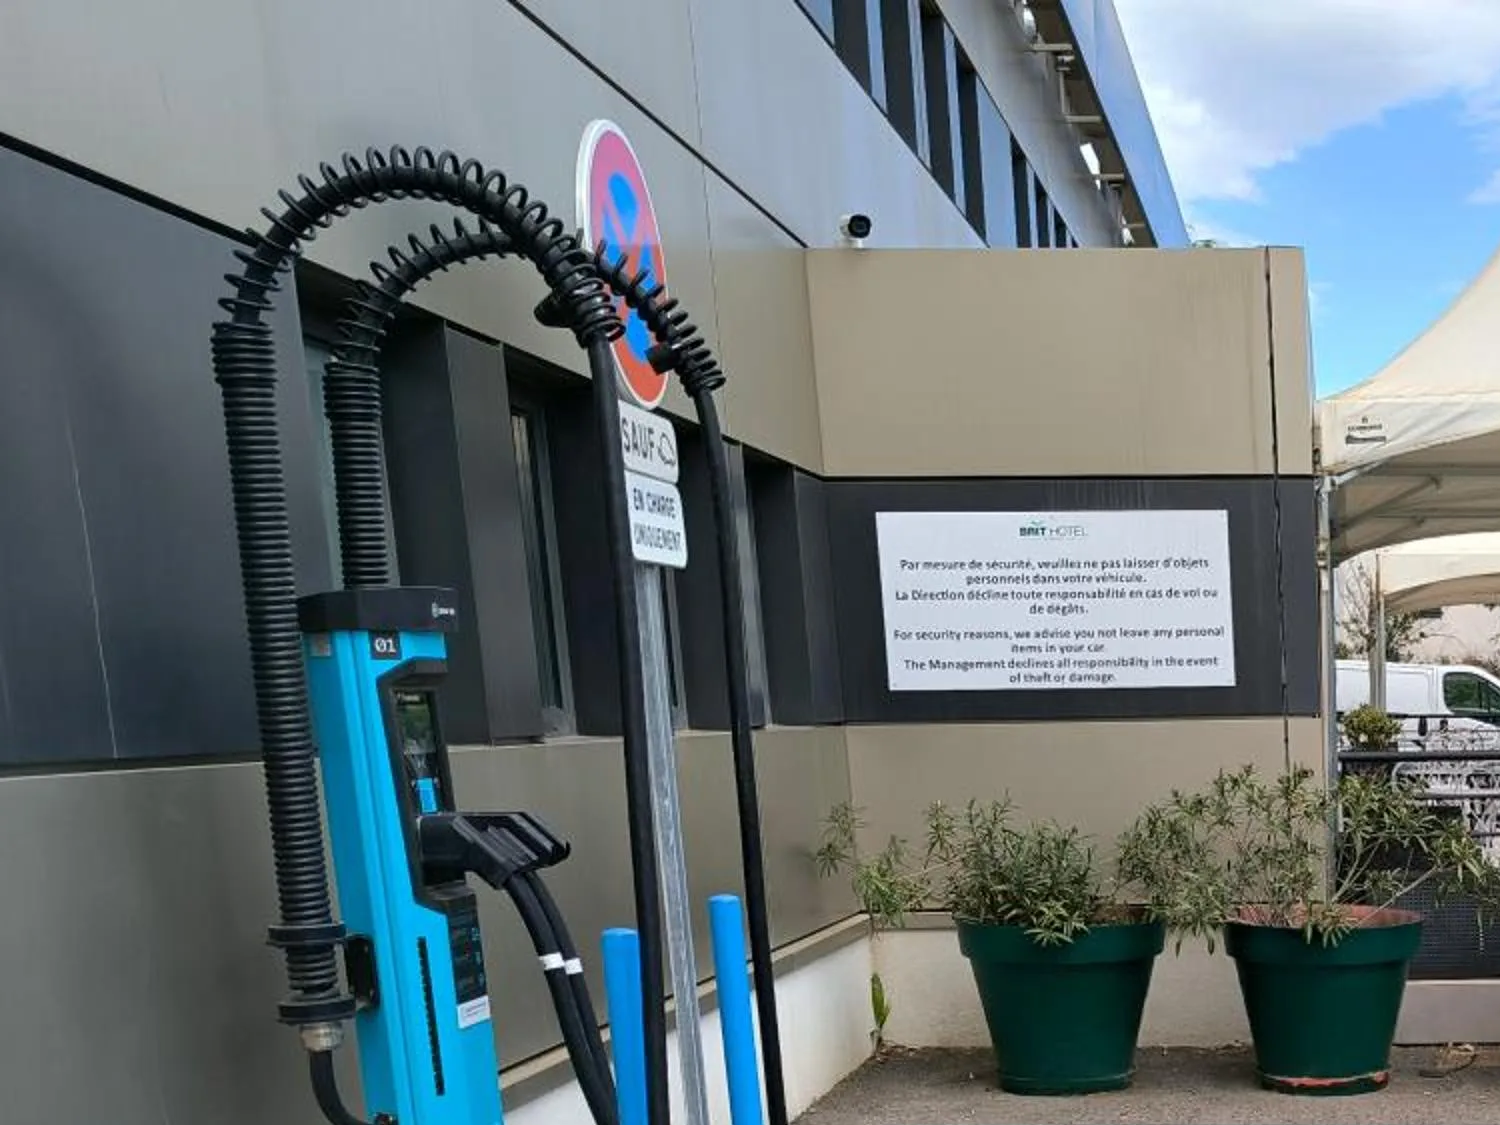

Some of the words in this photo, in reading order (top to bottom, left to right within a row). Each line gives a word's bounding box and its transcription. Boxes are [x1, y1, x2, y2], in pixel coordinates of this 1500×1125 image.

[621, 418, 655, 461] SAUF
[1049, 526, 1088, 536] HOTEL
[900, 559, 919, 570] Par
[922, 560, 966, 570] mesure
[968, 559, 983, 569] de
[985, 559, 1035, 570] sécurité,
[1037, 558, 1081, 569] veuillez
[1083, 559, 1098, 569] ne
[1101, 559, 1121, 571] pas
[1123, 557, 1160, 568] laisser
[966, 574, 1031, 585] personnels
[1032, 573, 1060, 584] dans
[1062, 573, 1093, 583] votre
[1095, 572, 1148, 583] véhicule.
[895, 590, 908, 600] La
[911, 589, 965, 601] Direction
[967, 588, 1008, 600] décline
[1011, 589, 1043, 599] toute
[1045, 588, 1126, 600] responsabilité
[1129, 589, 1143, 598] en
[1145, 588, 1163, 598] cas
[1165, 587, 1181, 598] de
[1183, 588, 1200, 598] vol
[1202, 588, 1218, 597] ou
[1029, 604, 1045, 614] de
[894, 629, 913, 640] For
[915, 629, 961, 641] security
[963, 629, 1012, 640] reasons,
[1014, 630, 1031, 639] we
[1034, 627, 1071, 639] advise
[1074, 629, 1095, 640] you
[1098, 628, 1117, 638] not
[1119, 627, 1150, 637] leave
[1153, 628, 1174, 638] any
[1175, 626, 1225, 638] personal
[374, 637, 397, 653] 01
[1011, 642, 1042, 653] items
[1045, 642, 1057, 653] in
[1059, 643, 1085, 654] your
[904, 659, 926, 671] The
[929, 659, 1005, 672] Management
[1007, 657, 1055, 669] declines
[1056, 657, 1071, 668] all
[1072, 656, 1149, 669] responsibility
[1151, 656, 1163, 667] in
[1164, 655, 1184, 667] the
[1185, 656, 1219, 666] event
[1009, 672, 1021, 683] of
[1023, 672, 1051, 683] theft
[1053, 674, 1066, 683] or
